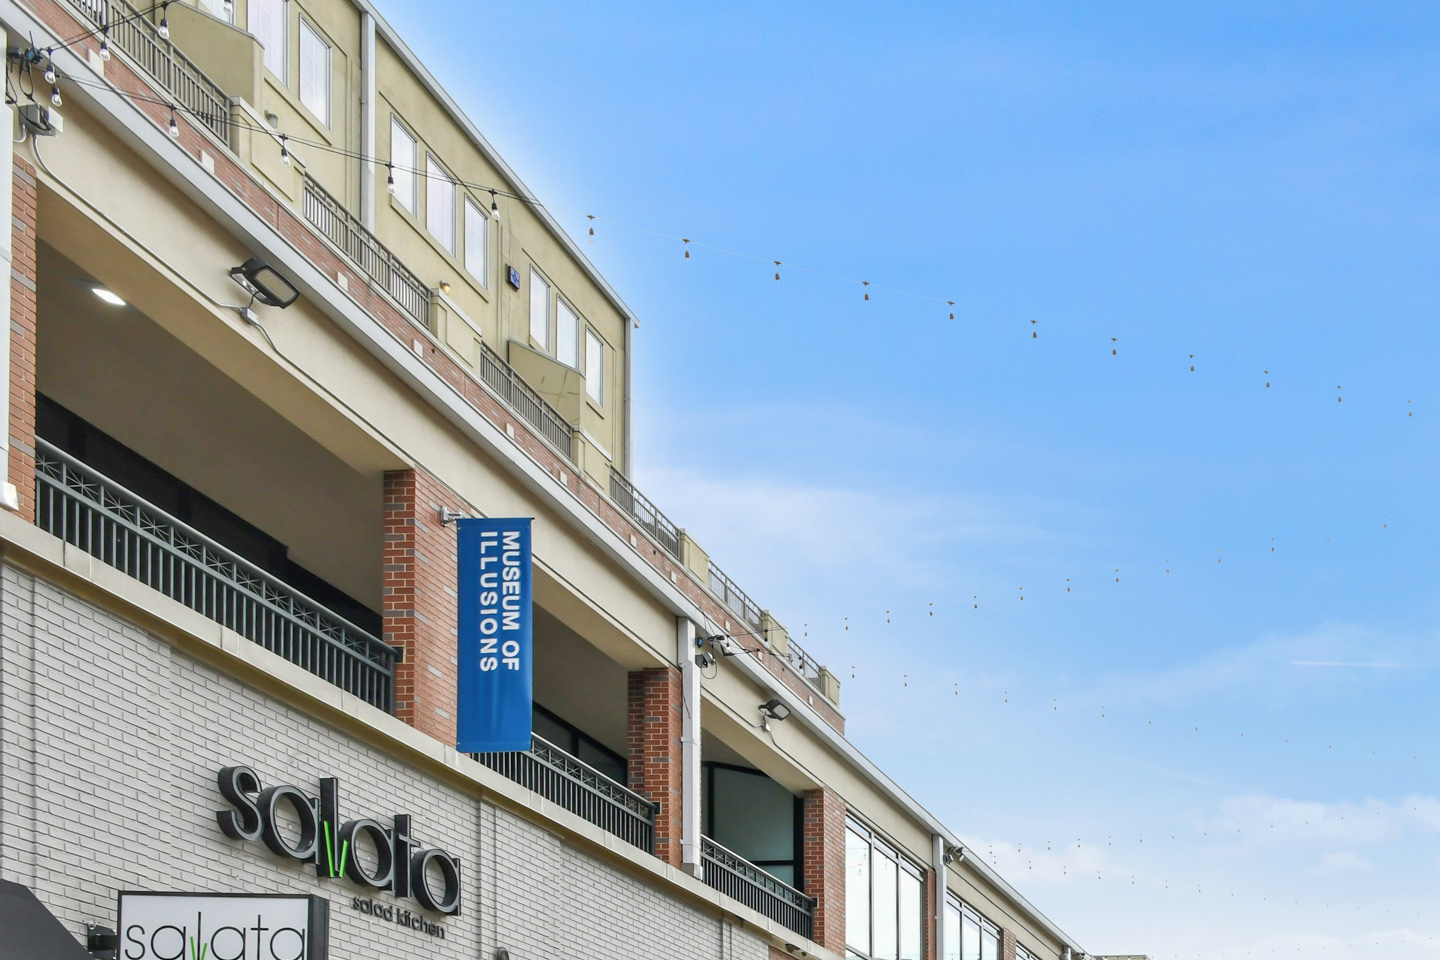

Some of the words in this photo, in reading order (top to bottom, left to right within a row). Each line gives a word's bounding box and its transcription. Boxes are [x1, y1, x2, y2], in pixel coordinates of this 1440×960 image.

[480, 531, 498, 672] ILLUSIONS
[502, 531, 520, 631] MUSEUM
[502, 640, 520, 671] OF
[216, 766, 461, 916] salata
[353, 897, 394, 922] salad
[396, 908, 446, 939] kitchen
